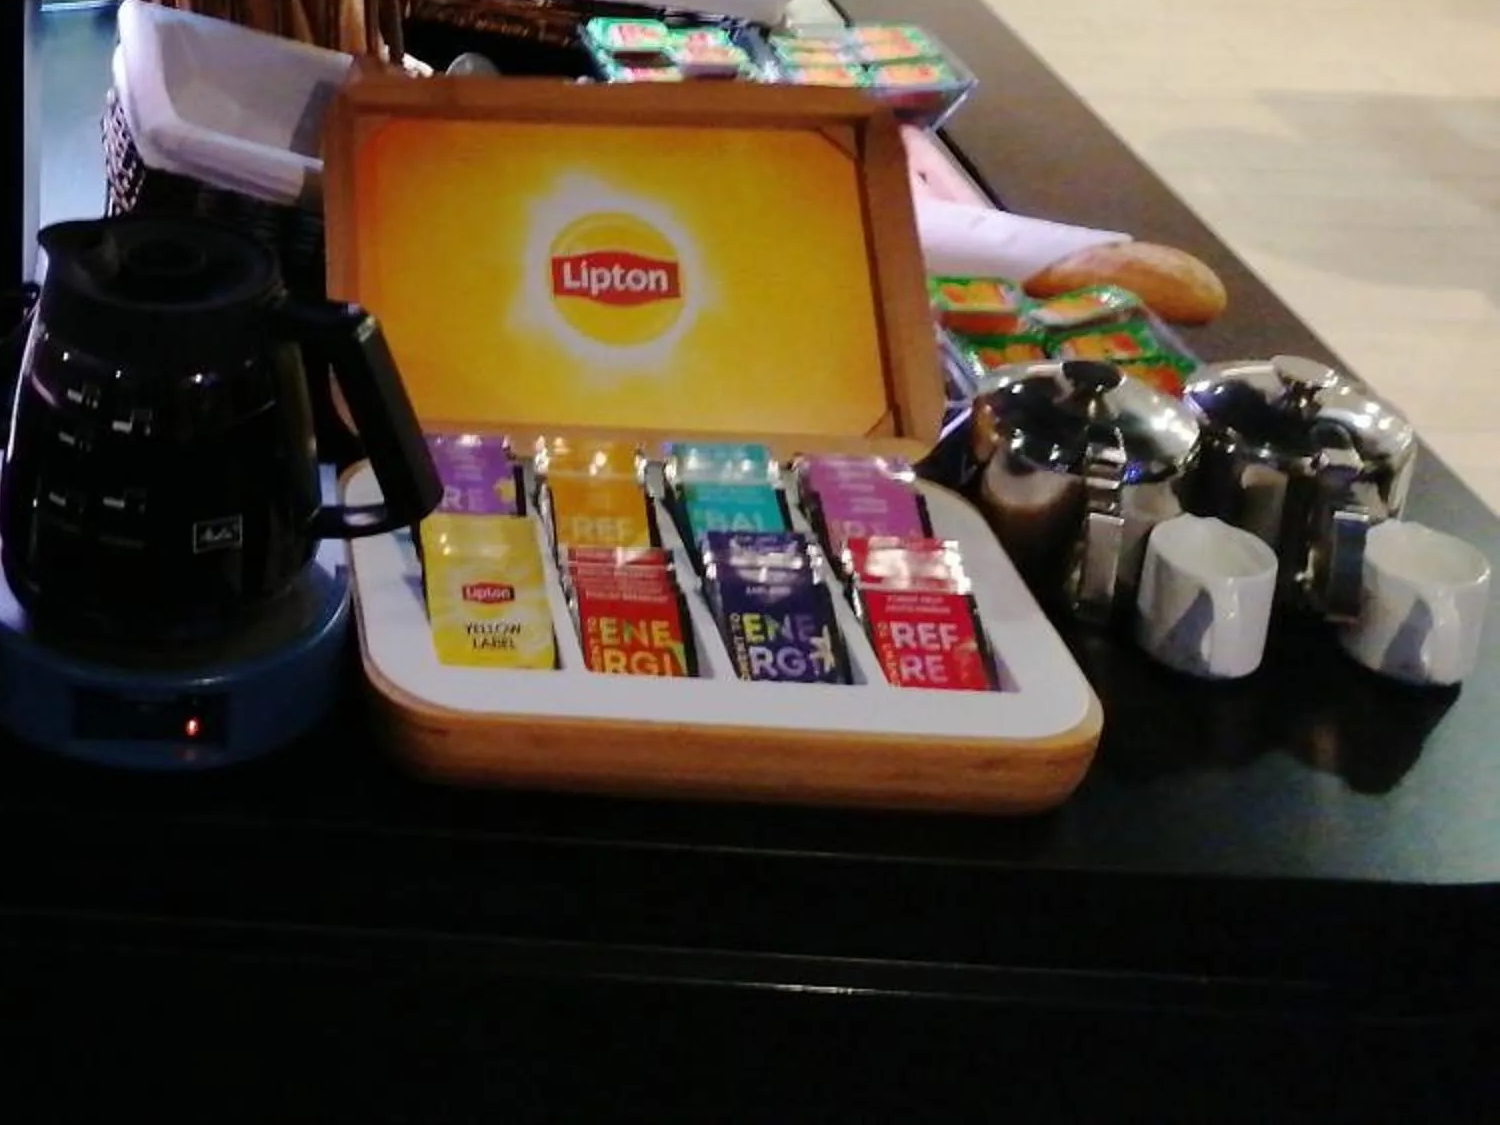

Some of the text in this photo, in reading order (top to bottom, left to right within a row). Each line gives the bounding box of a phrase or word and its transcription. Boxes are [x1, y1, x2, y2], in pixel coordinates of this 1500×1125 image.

[562, 260, 669, 296] Lipton
[466, 585, 511, 601] Lipton
[467, 622, 521, 635] YELLOW
[600, 616, 673, 649] ENE
[742, 612, 818, 644] ENE
[889, 620, 960, 652] REF
[473, 637, 515, 650] LABEL
[901, 654, 949, 683] RE
